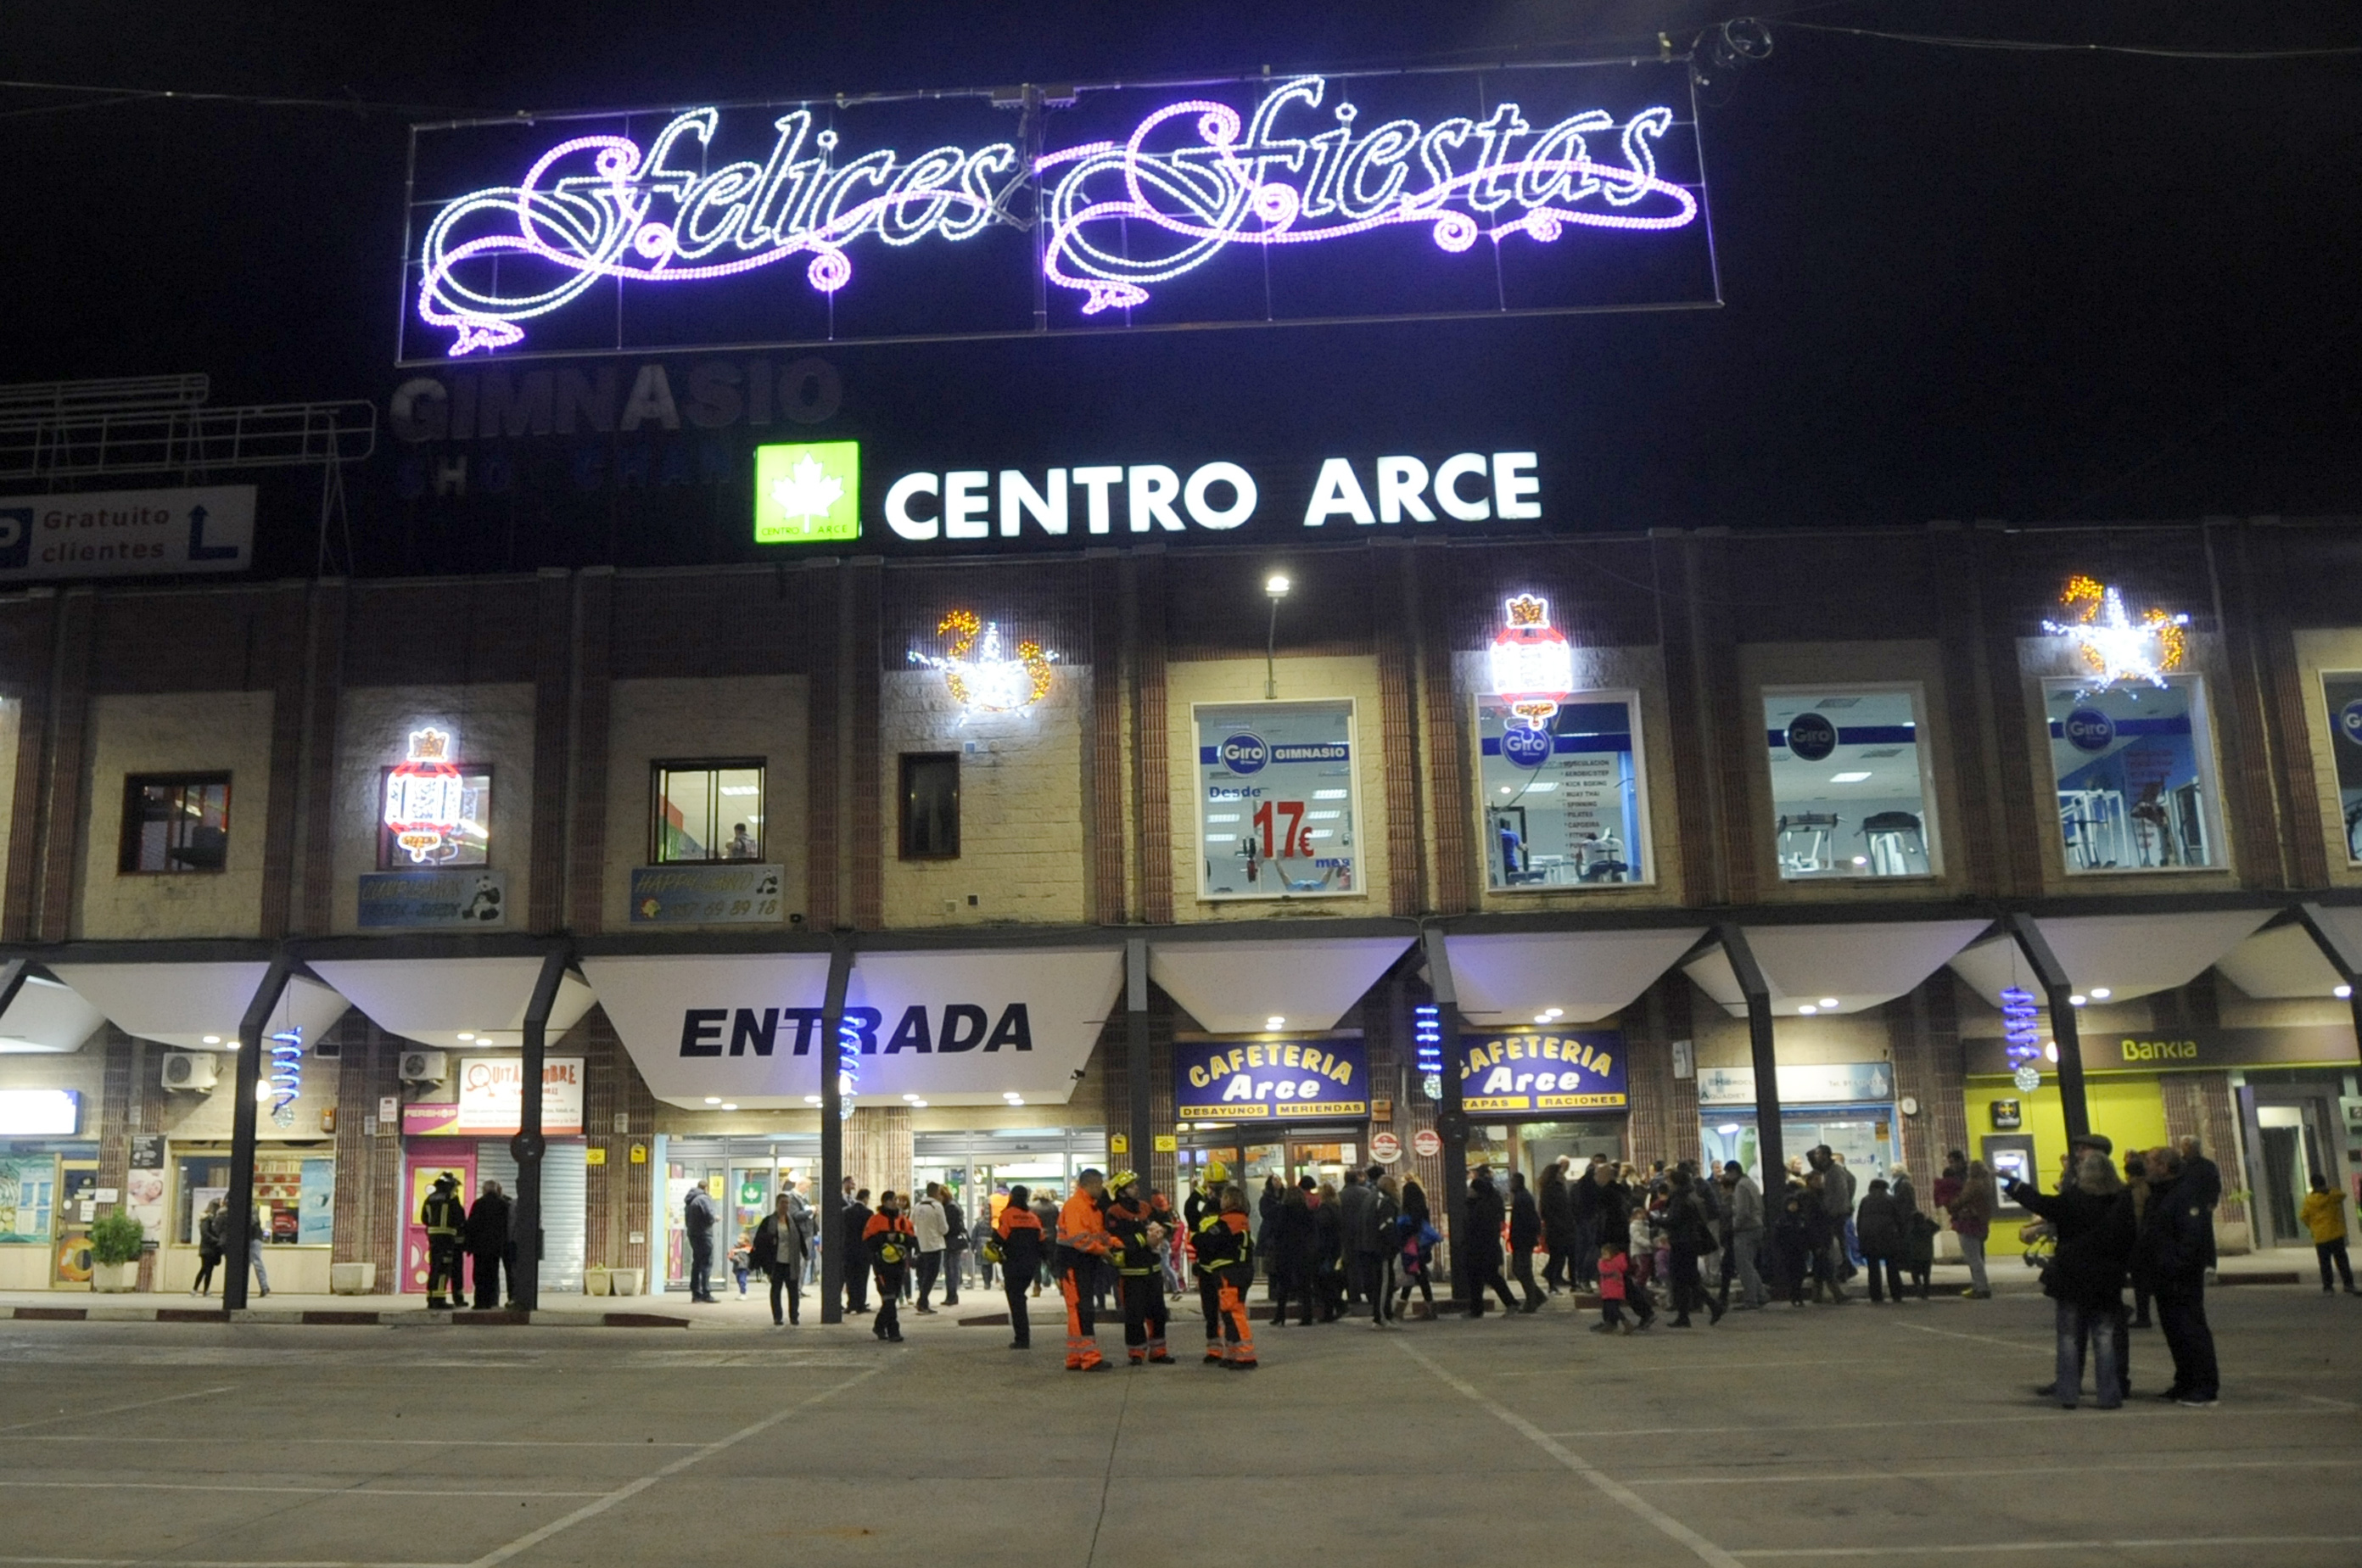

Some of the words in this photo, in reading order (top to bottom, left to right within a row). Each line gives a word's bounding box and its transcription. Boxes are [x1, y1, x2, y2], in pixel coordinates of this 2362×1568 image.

[389, 357, 842, 443] GIMNASIO
[884, 461, 1258, 540] CENTRO
[1303, 451, 1542, 528] ARCE
[42, 507, 170, 530] Gratuito
[761, 527, 799, 536] CENTRO
[816, 524, 848, 534] ARCE
[42, 540, 165, 563] clientes
[2070, 721, 2108, 736] Giro
[1224, 744, 1264, 760] Giro
[1275, 747, 1346, 760] GIMNASIO
[1507, 736, 1545, 752] Giro
[1209, 786, 1262, 798] Desde
[1316, 858, 1351, 868] mes
[757, 899, 778, 916] 18
[680, 1003, 1033, 1057] ENTRADA
[2122, 1039, 2197, 1061] Bankia
[466, 1063, 577, 1089] QUITAMBRE
[1189, 1044, 1353, 1088] CAFETERIA
[1222, 1074, 1320, 1101] Arce
[1483, 1067, 1580, 1094] Arce
[1184, 1106, 1264, 1116] DESAYUNOS
[1279, 1103, 1362, 1113] MERIENDAS
[1463, 1099, 1509, 1108] TAPAS
[1545, 1095, 1619, 1106] RACIONES
